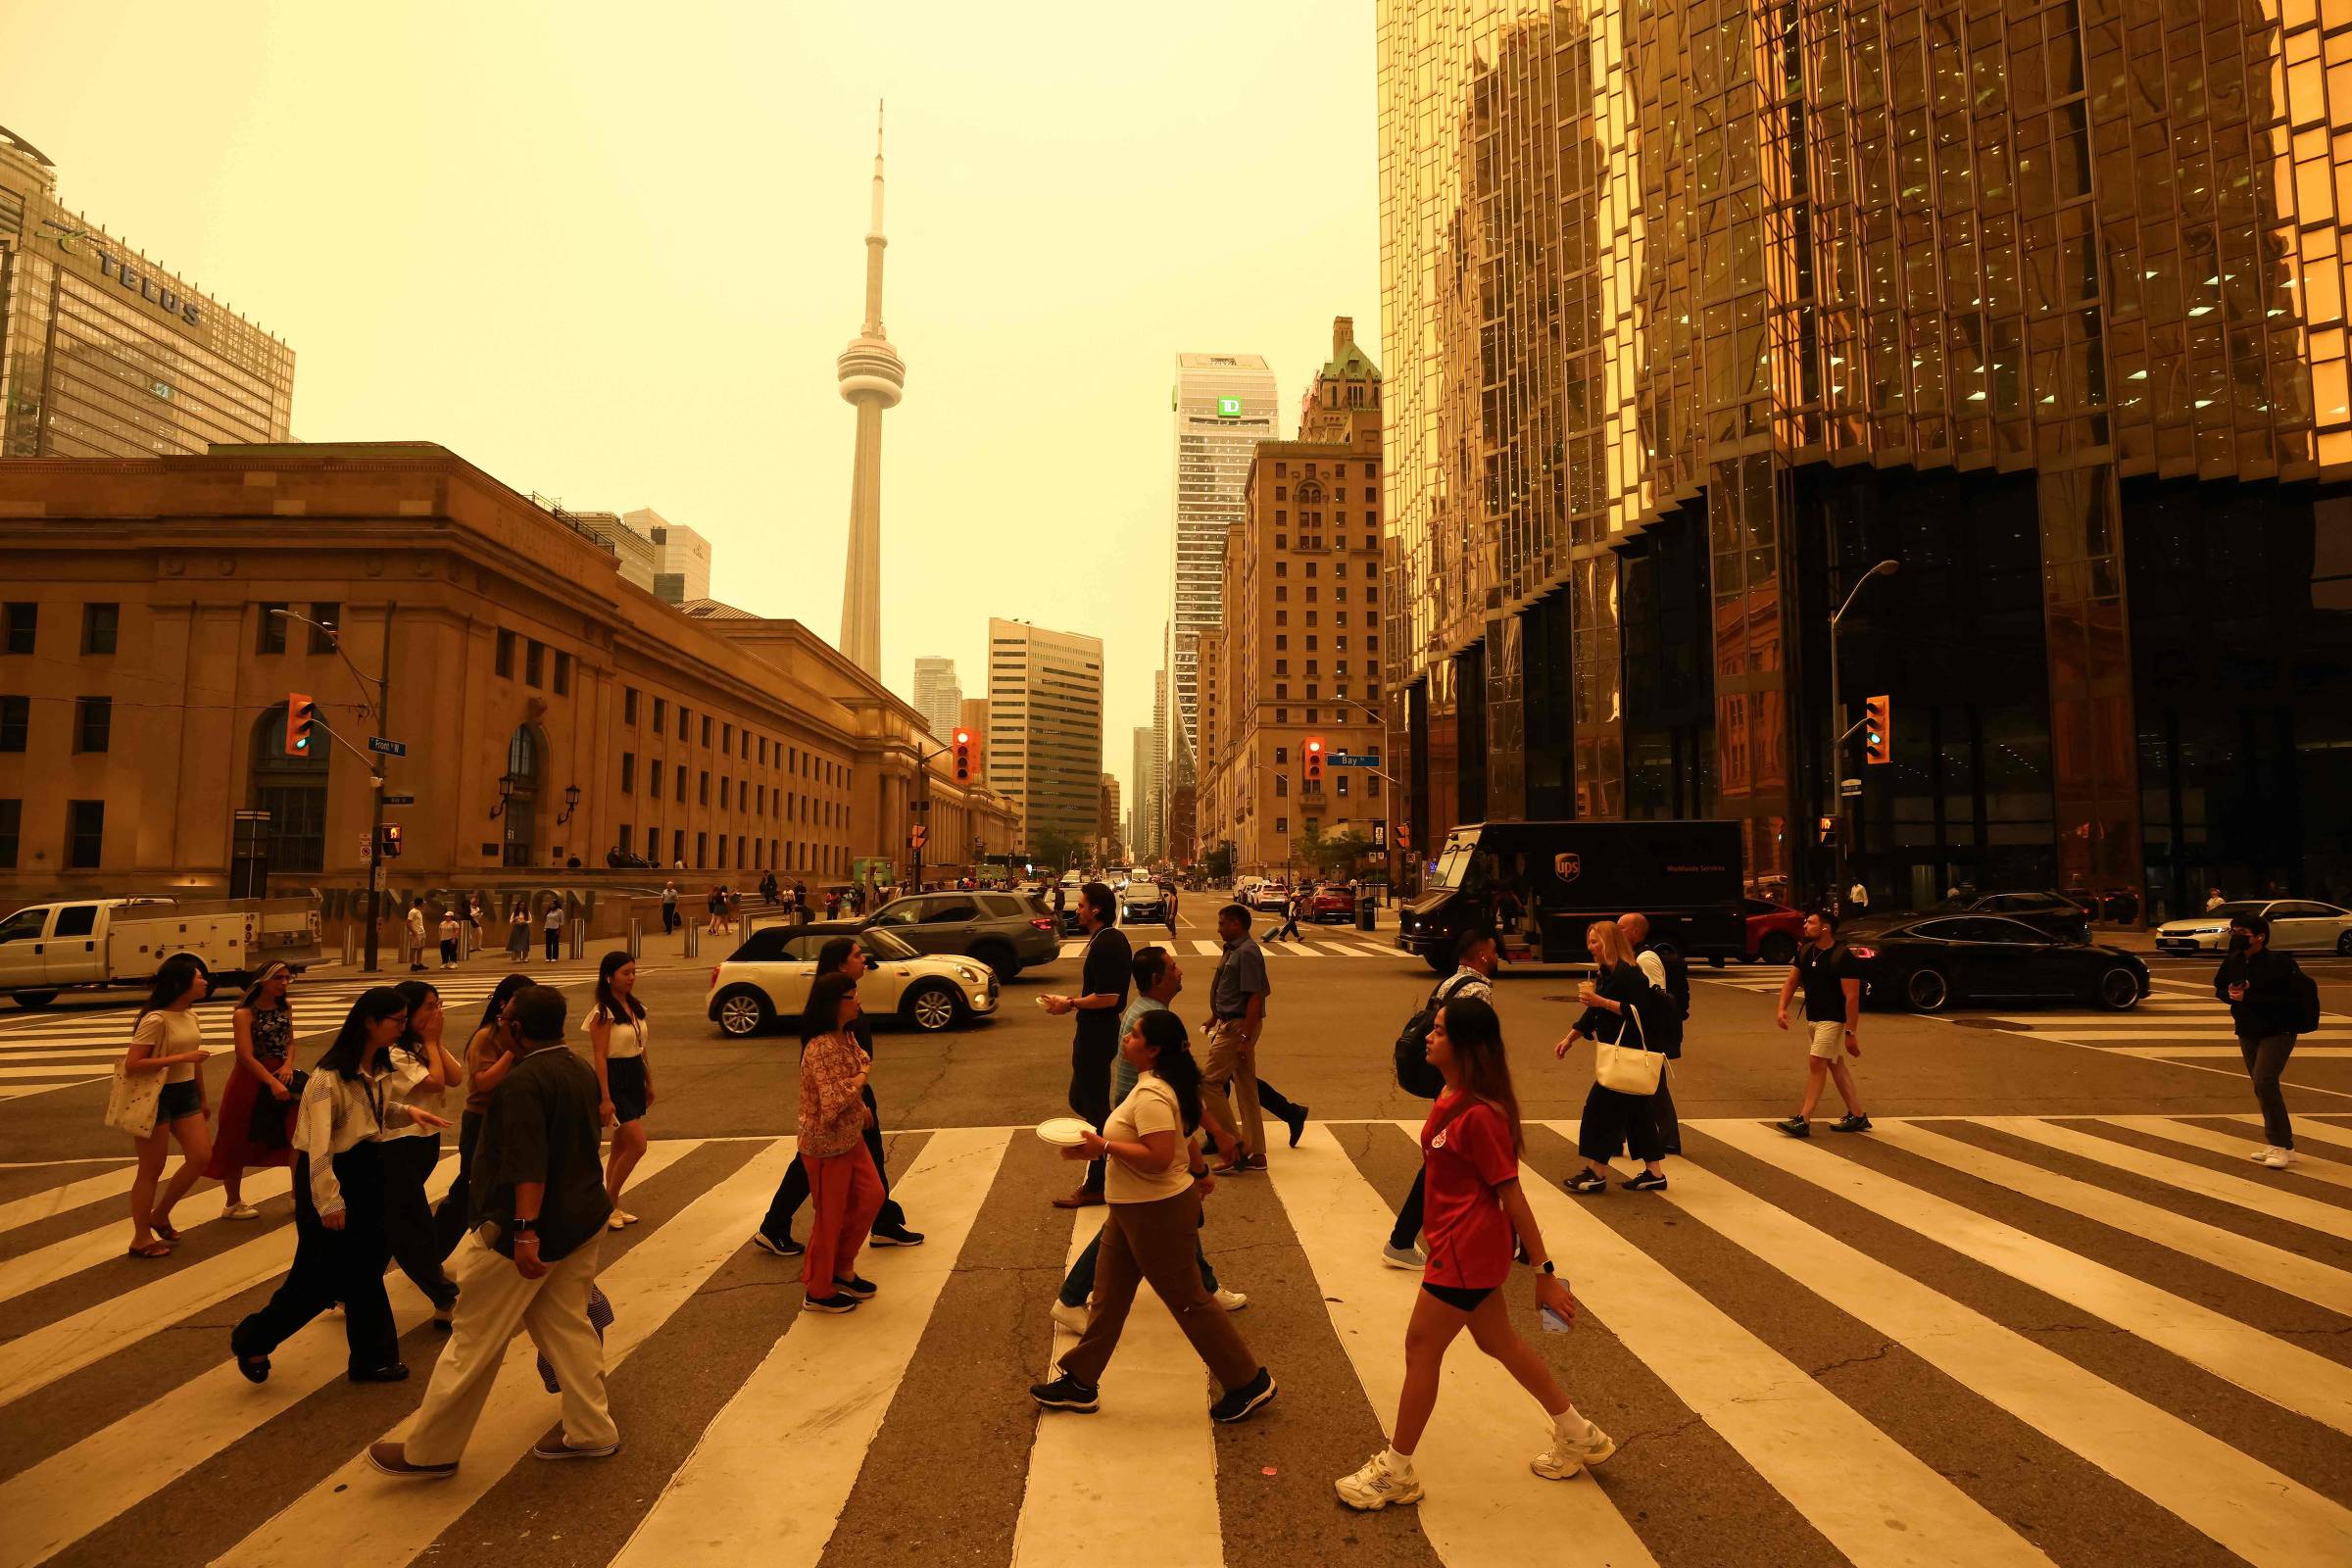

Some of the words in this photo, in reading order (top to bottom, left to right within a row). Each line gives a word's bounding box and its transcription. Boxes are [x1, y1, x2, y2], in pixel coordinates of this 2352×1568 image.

[98, 249, 201, 326] TELUS
[1220, 399, 1240, 413] TD
[375, 739, 390, 752] Front
[1342, 757, 1357, 766] Bay
[508, 829, 514, 840] 61
[1557, 861, 1579, 878] ups
